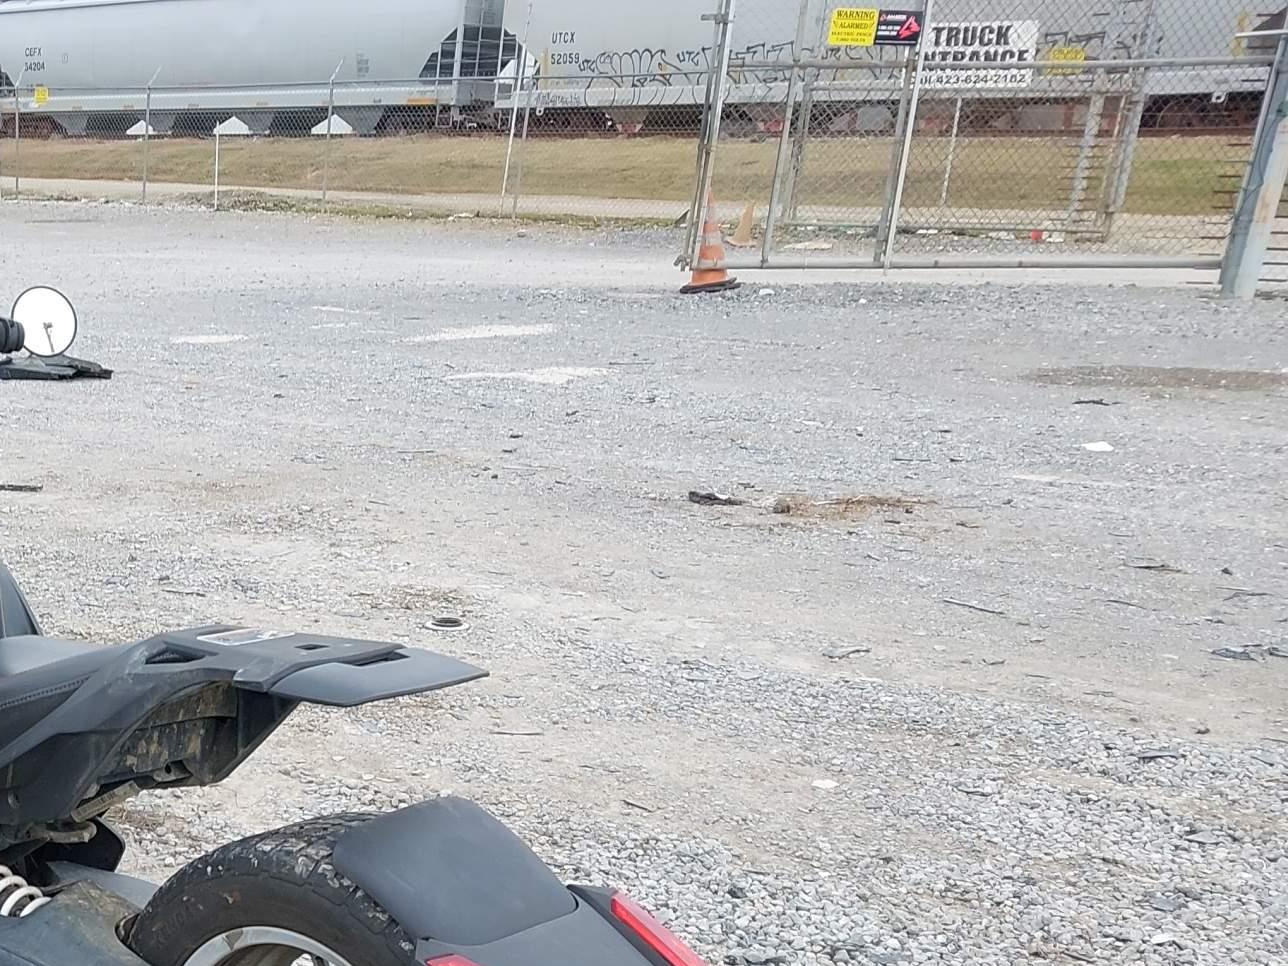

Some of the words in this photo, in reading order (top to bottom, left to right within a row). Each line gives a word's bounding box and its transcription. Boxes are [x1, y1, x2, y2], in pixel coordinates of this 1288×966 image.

[837, 10, 875, 20] WARNING
[551, 31, 576, 44] UTCX
[932, 24, 1013, 47] TRUCK
[550, 52, 580, 65] 52059
[918, 49, 1029, 70] NTRANCE
